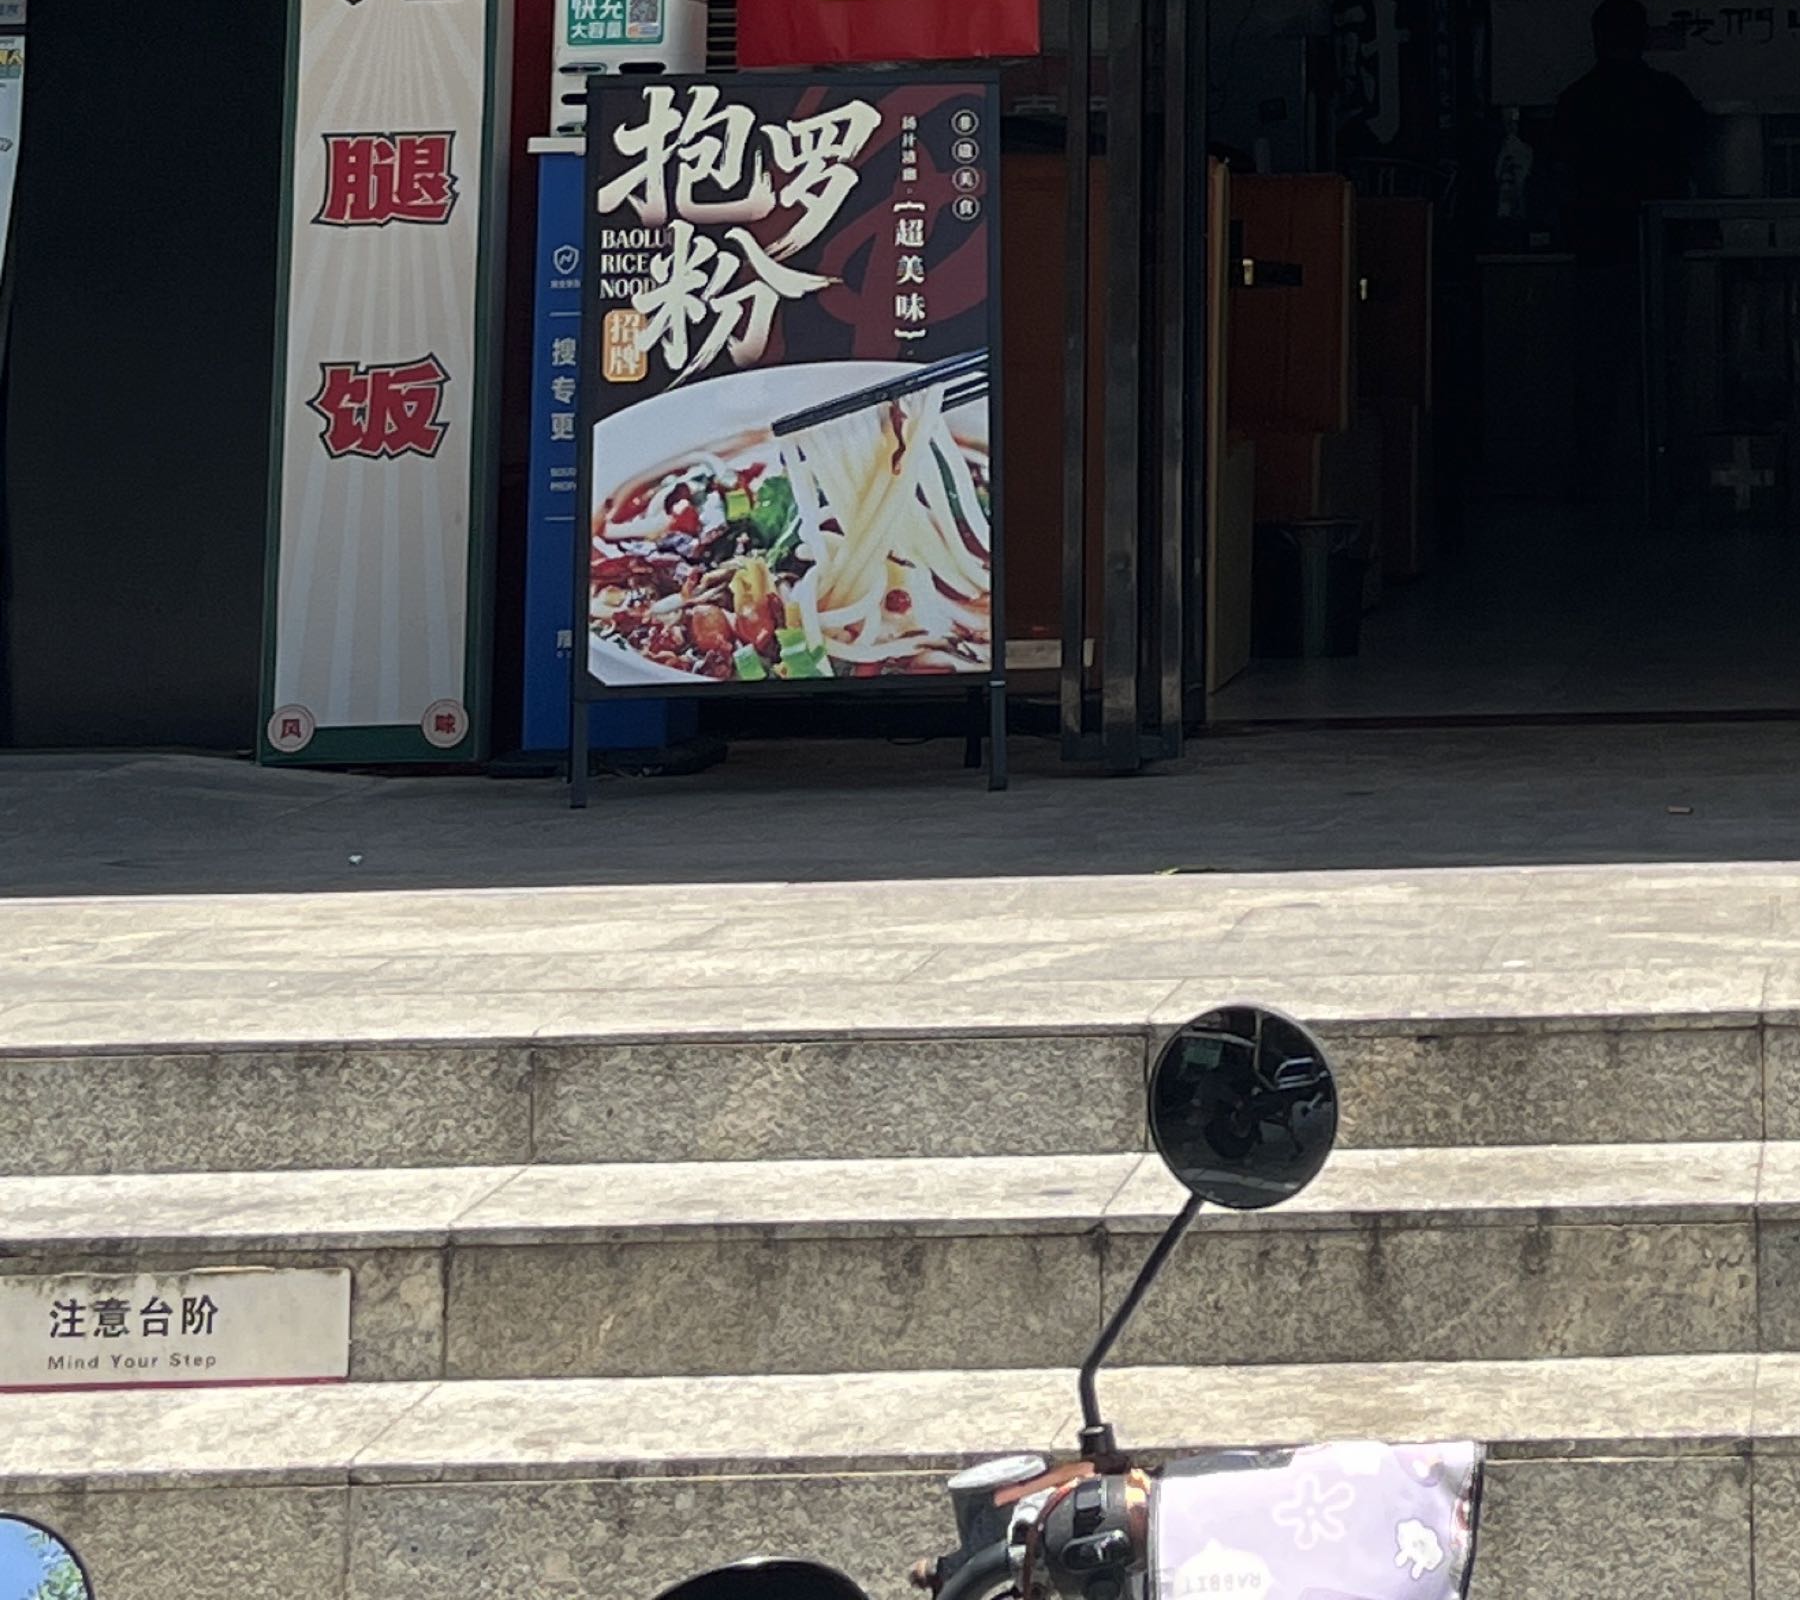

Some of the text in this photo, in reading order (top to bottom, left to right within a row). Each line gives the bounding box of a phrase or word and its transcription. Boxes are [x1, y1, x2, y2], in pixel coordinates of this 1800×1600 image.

[570, 21, 623, 39] 大容量
[600, 253, 649, 275] RICE
[48, 1294, 220, 1339] 注意台阶
[47, 1351, 217, 1371] Mind Your Step
